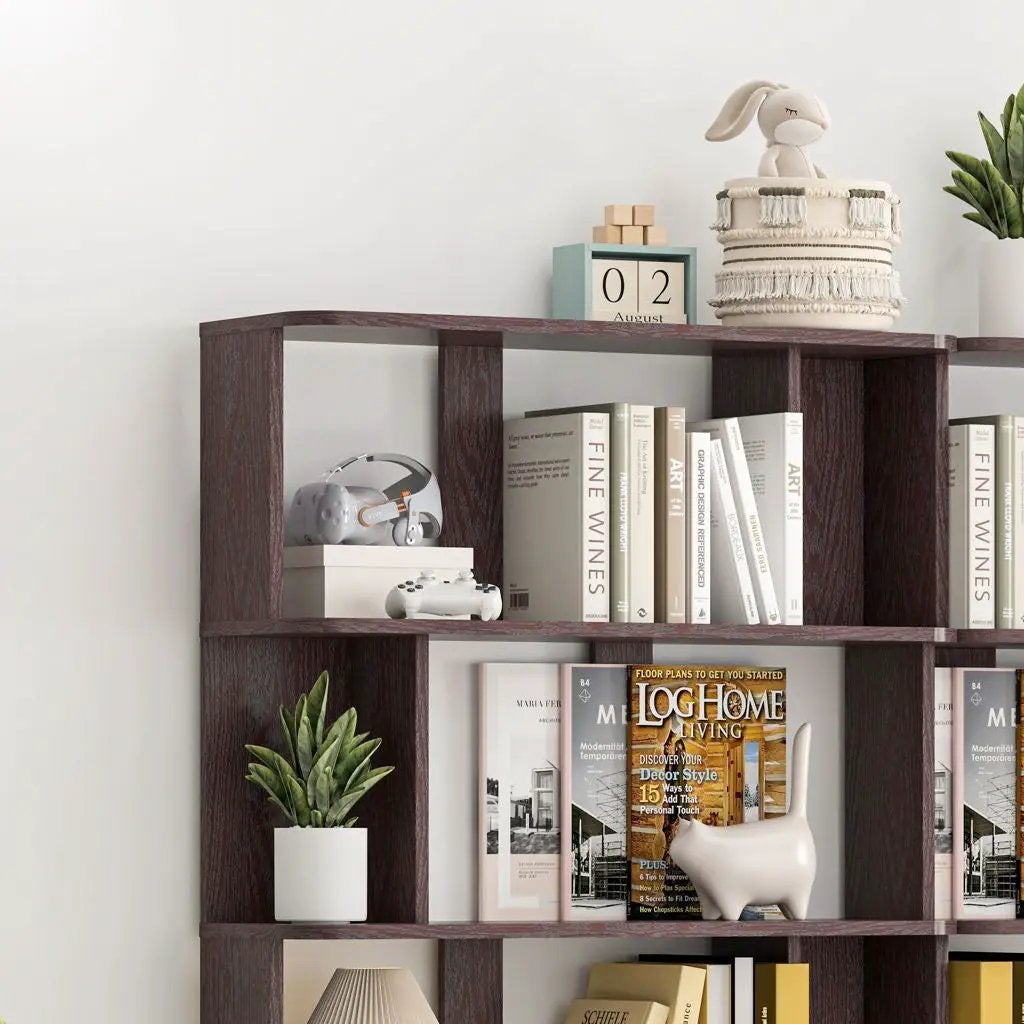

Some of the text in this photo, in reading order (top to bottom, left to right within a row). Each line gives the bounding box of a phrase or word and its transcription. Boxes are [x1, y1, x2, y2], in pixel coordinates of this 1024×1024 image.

[614, 312, 664, 323] August
[589, 442, 604, 498] FINE
[670, 458, 683, 492] ART
[788, 463, 800, 496] ART
[975, 453, 990, 601] FINE WINES
[589, 511, 604, 595] WINES
[636, 670, 783, 680] FLOOR PLANS TO GET YOU STARTED
[679, 723, 742, 738] LIVING
[640, 755, 703, 764] DISCOVER YOUR
[639, 767, 718, 785] Decor Style
[639, 784, 660, 803] 15
